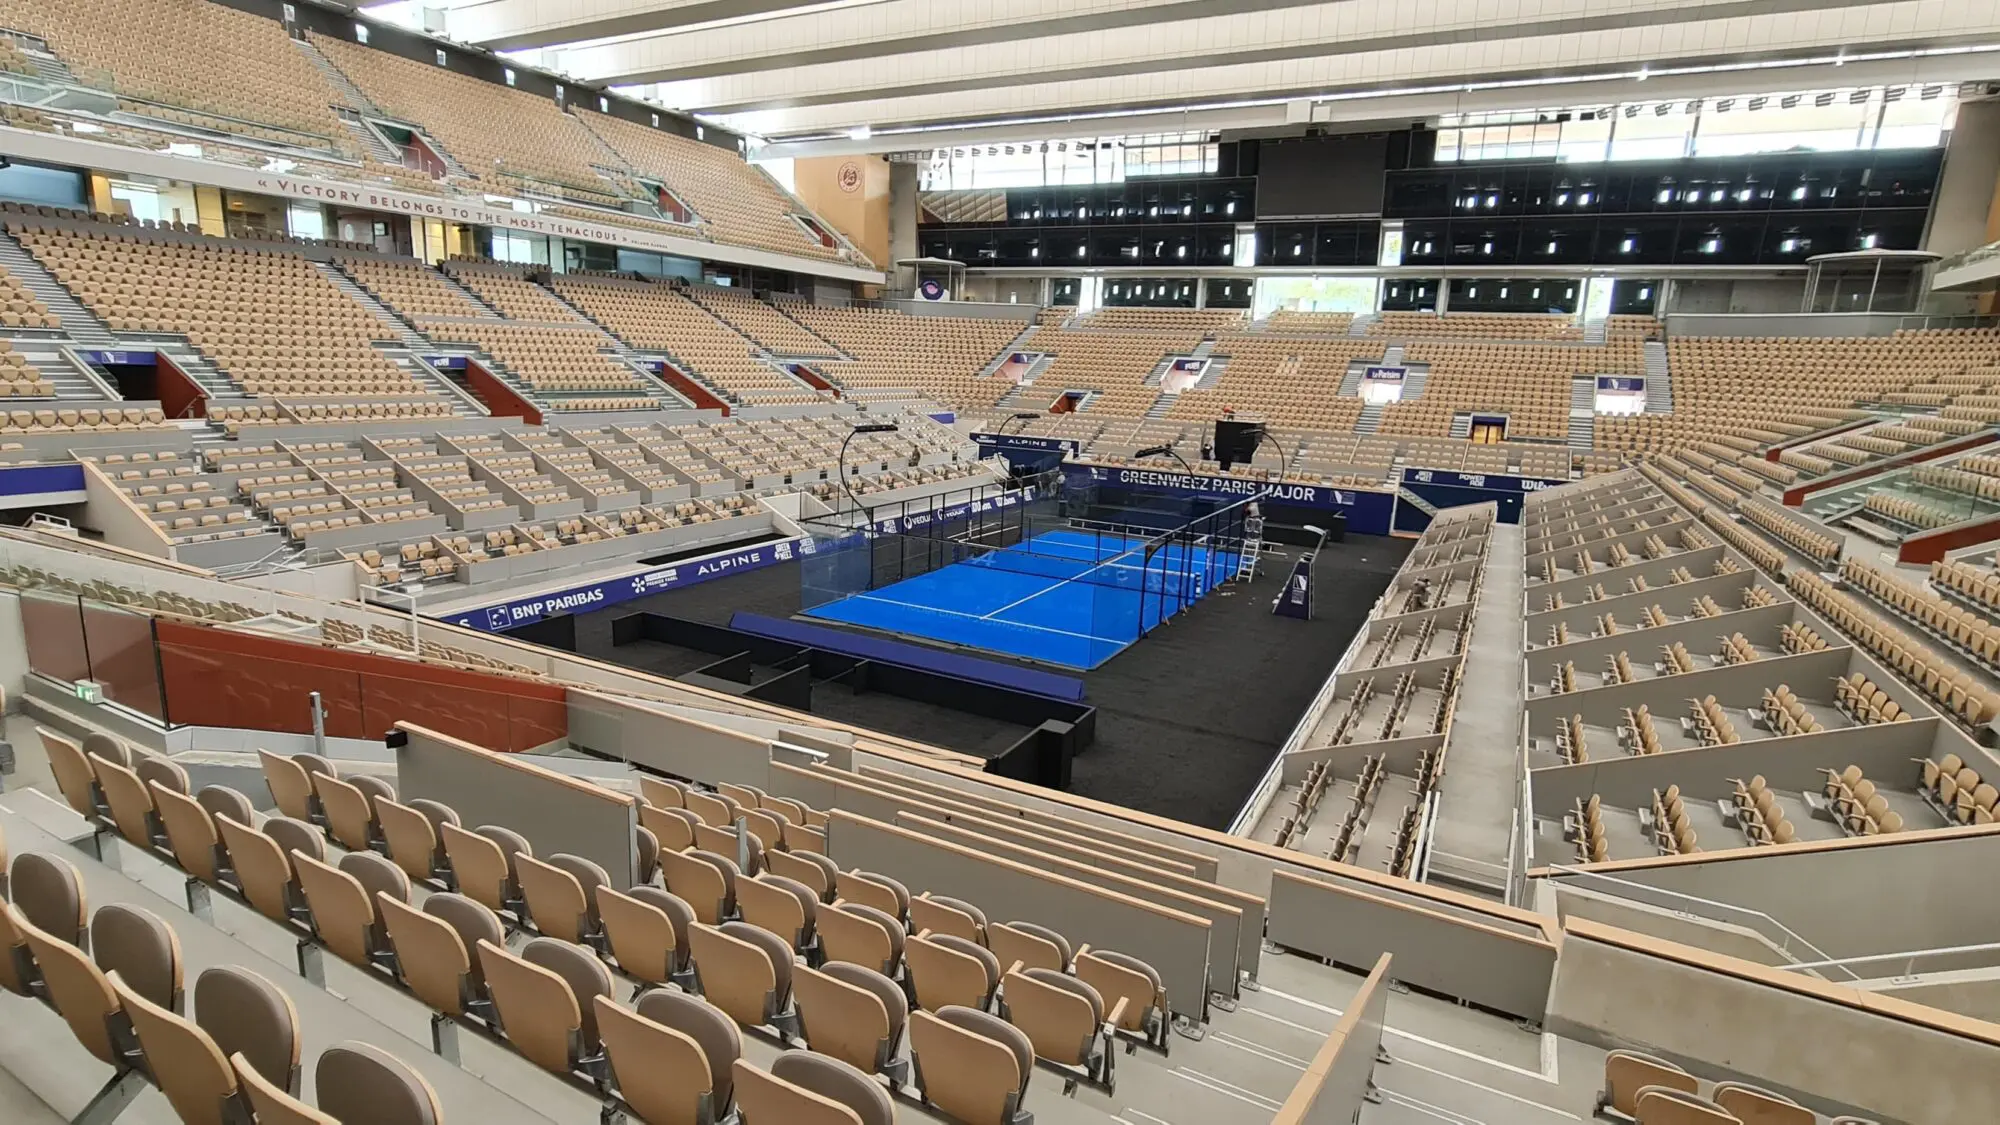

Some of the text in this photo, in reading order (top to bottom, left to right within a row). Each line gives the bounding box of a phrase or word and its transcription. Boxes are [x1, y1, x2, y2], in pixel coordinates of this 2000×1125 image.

[277, 179, 360, 203] VICTORY
[370, 195, 443, 215] BELONGS
[451, 207, 469, 219] TO
[476, 211, 503, 225] THE
[510, 217, 545, 231] MOST
[550, 222, 618, 242] TENACIOUS
[1008, 438, 1048, 447] ALPINE
[1120, 470, 1209, 491] GREENWEEZ
[1212, 478, 1256, 496] PARIS
[1261, 484, 1316, 502] MAJOR
[698, 552, 761, 576] ALPINE
[512, 588, 604, 620] BNP PARIBAS
